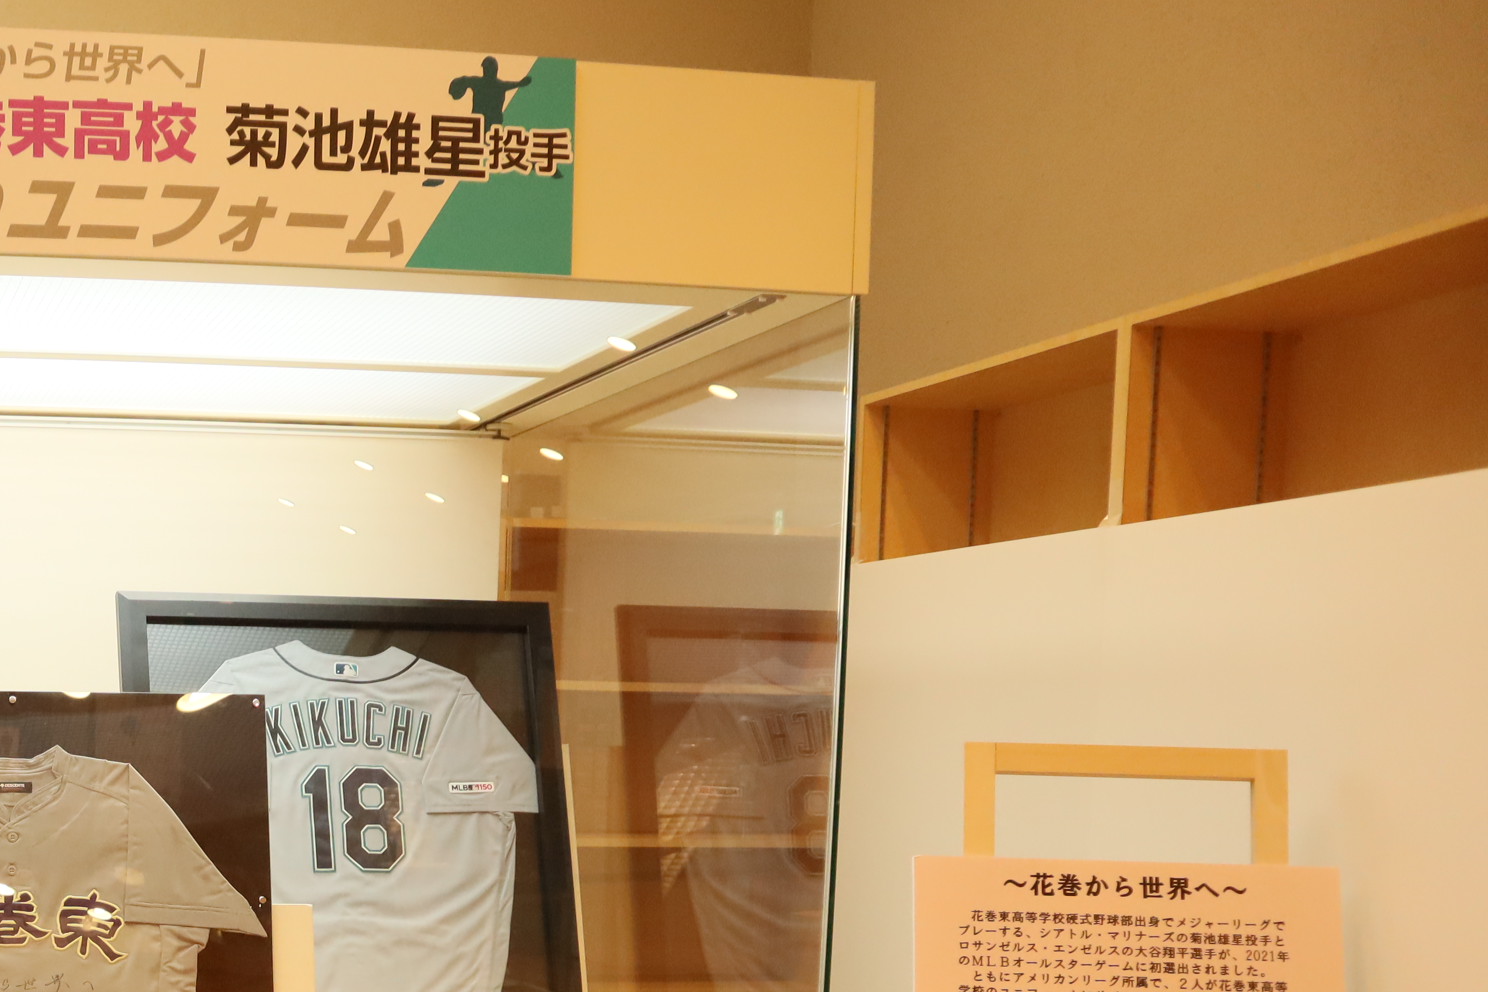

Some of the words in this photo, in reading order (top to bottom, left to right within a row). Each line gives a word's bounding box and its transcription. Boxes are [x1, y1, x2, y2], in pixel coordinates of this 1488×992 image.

[225, 102, 572, 180] 菊池雄星投手
[265, 697, 432, 759] KIKUCHI
[301, 764, 407, 873] 18
